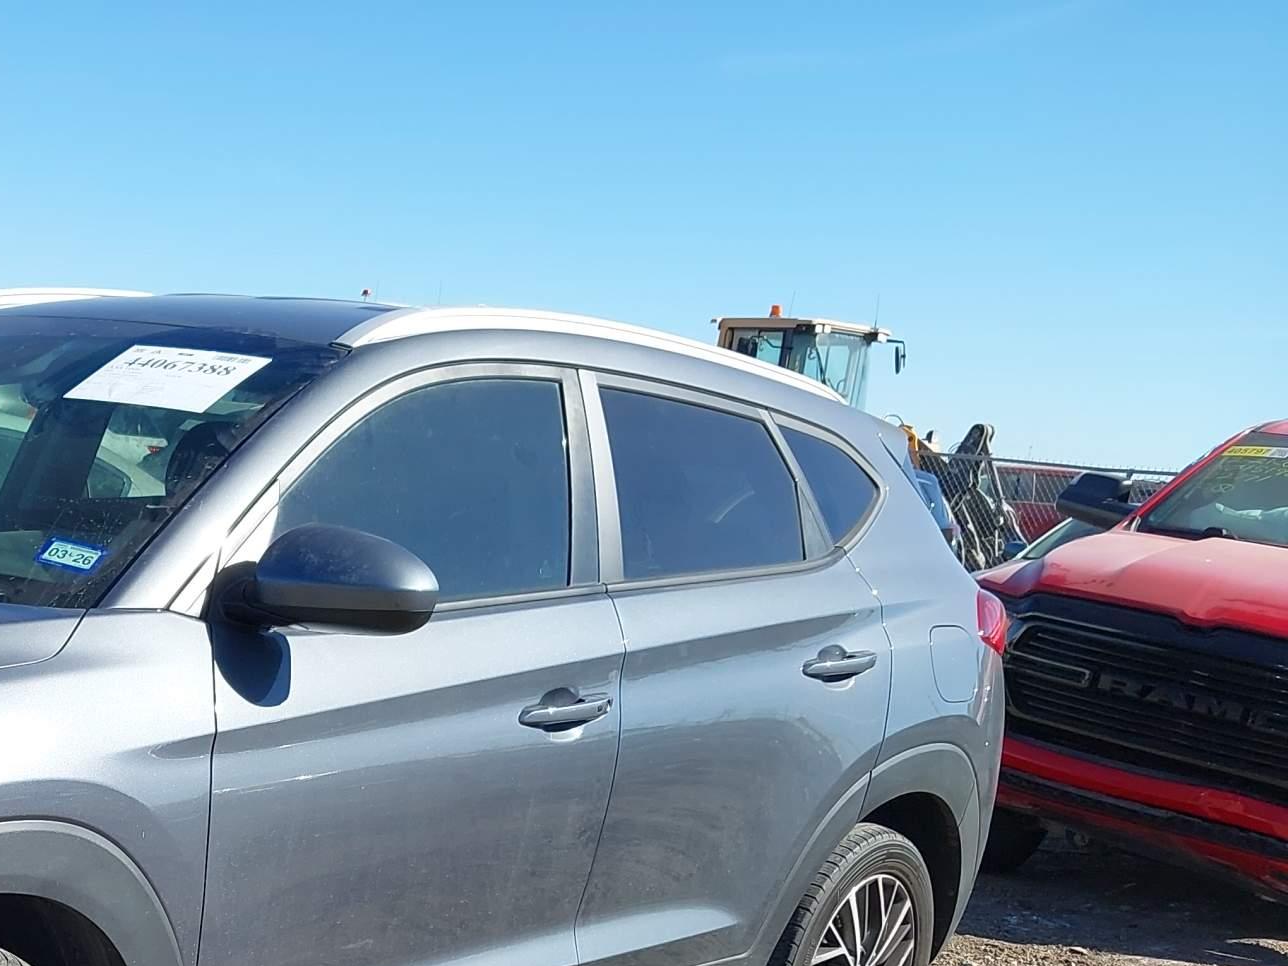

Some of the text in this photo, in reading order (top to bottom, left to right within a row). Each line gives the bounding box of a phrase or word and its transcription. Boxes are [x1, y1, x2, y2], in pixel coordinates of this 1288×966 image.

[125, 357, 237, 376] 44067388
[48, 547, 68, 560] 03
[71, 553, 94, 566] 26
[1098, 672, 1243, 723] RAM
